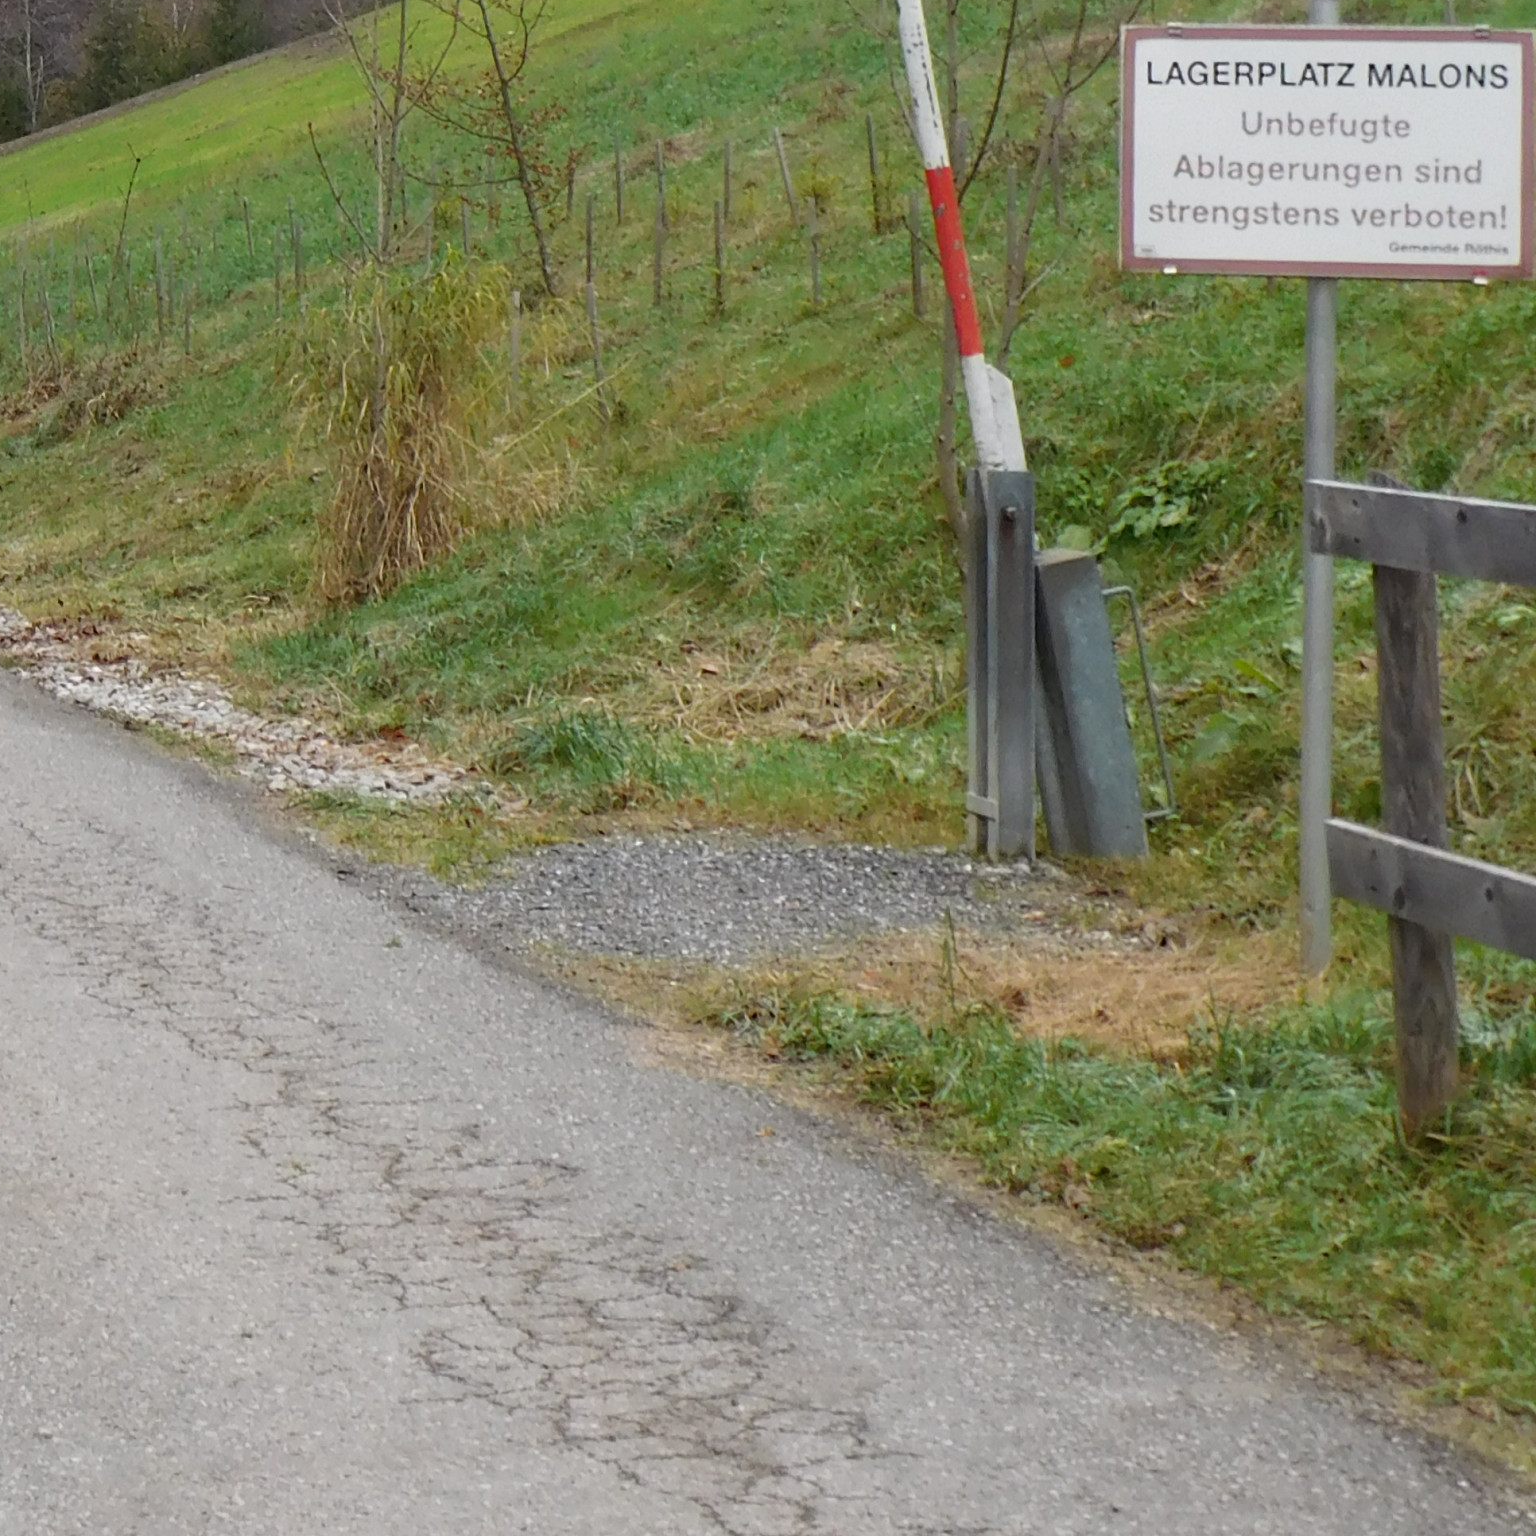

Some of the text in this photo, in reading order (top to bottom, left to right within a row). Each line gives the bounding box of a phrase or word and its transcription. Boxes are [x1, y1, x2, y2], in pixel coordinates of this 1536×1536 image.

[1147, 61, 1509, 89] LAGERPLATZ MALONS
[1240, 111, 1411, 143] Unbefugte
[1173, 154, 1482, 187] Ablagerungen sind
[1148, 200, 1507, 230] strengstens verboten!
[1389, 242, 1459, 254] Gemeinde
